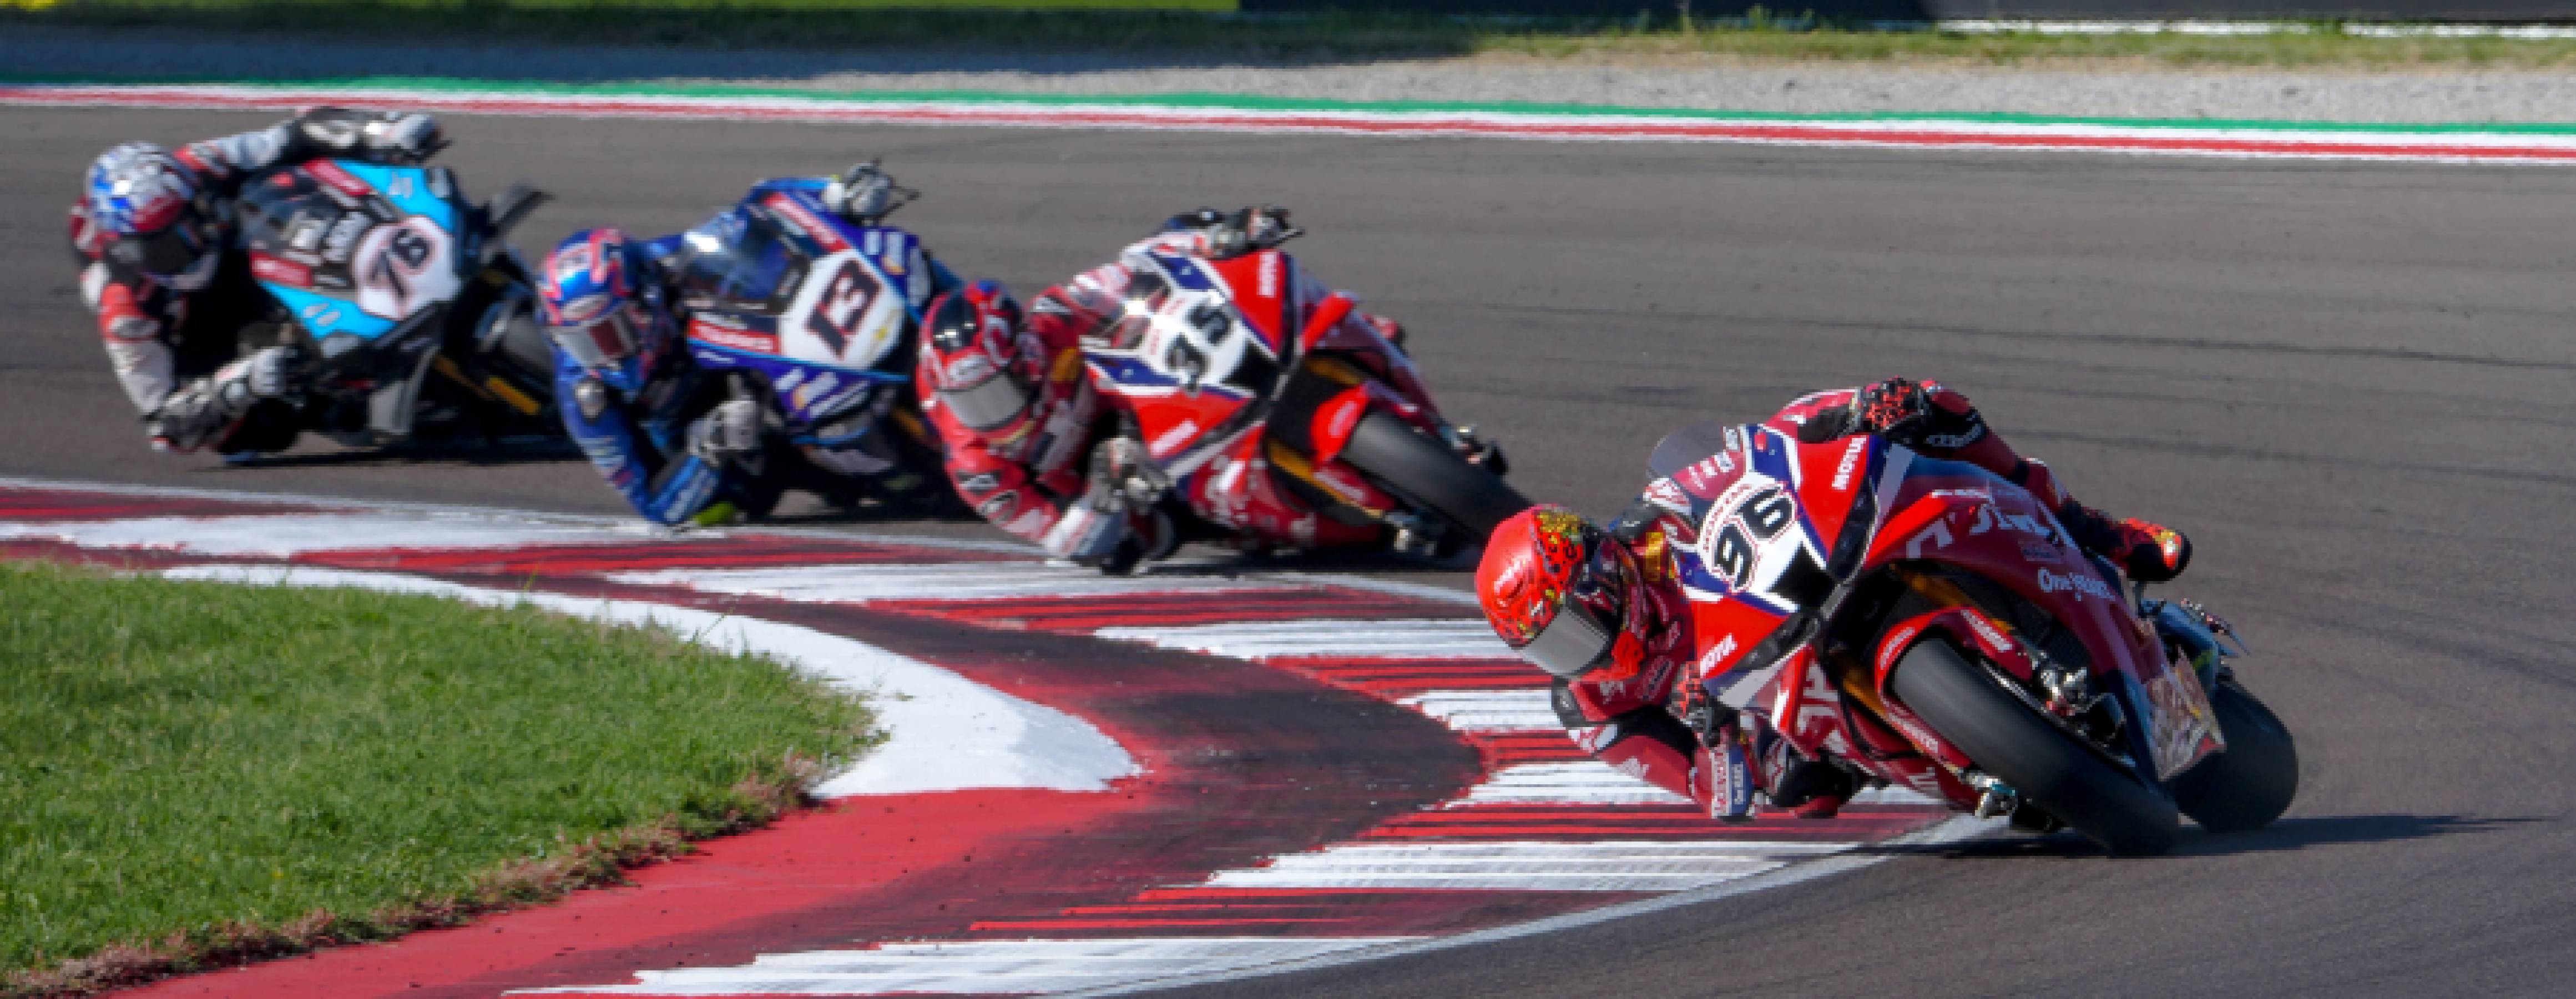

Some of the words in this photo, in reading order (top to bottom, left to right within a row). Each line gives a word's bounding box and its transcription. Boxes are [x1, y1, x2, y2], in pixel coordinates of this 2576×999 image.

[368, 226, 434, 301] 76
[804, 259, 884, 361] 13
[1165, 300, 1233, 394] 35
[1831, 435, 1866, 490] MOTUL
[1713, 485, 1795, 591] 96
